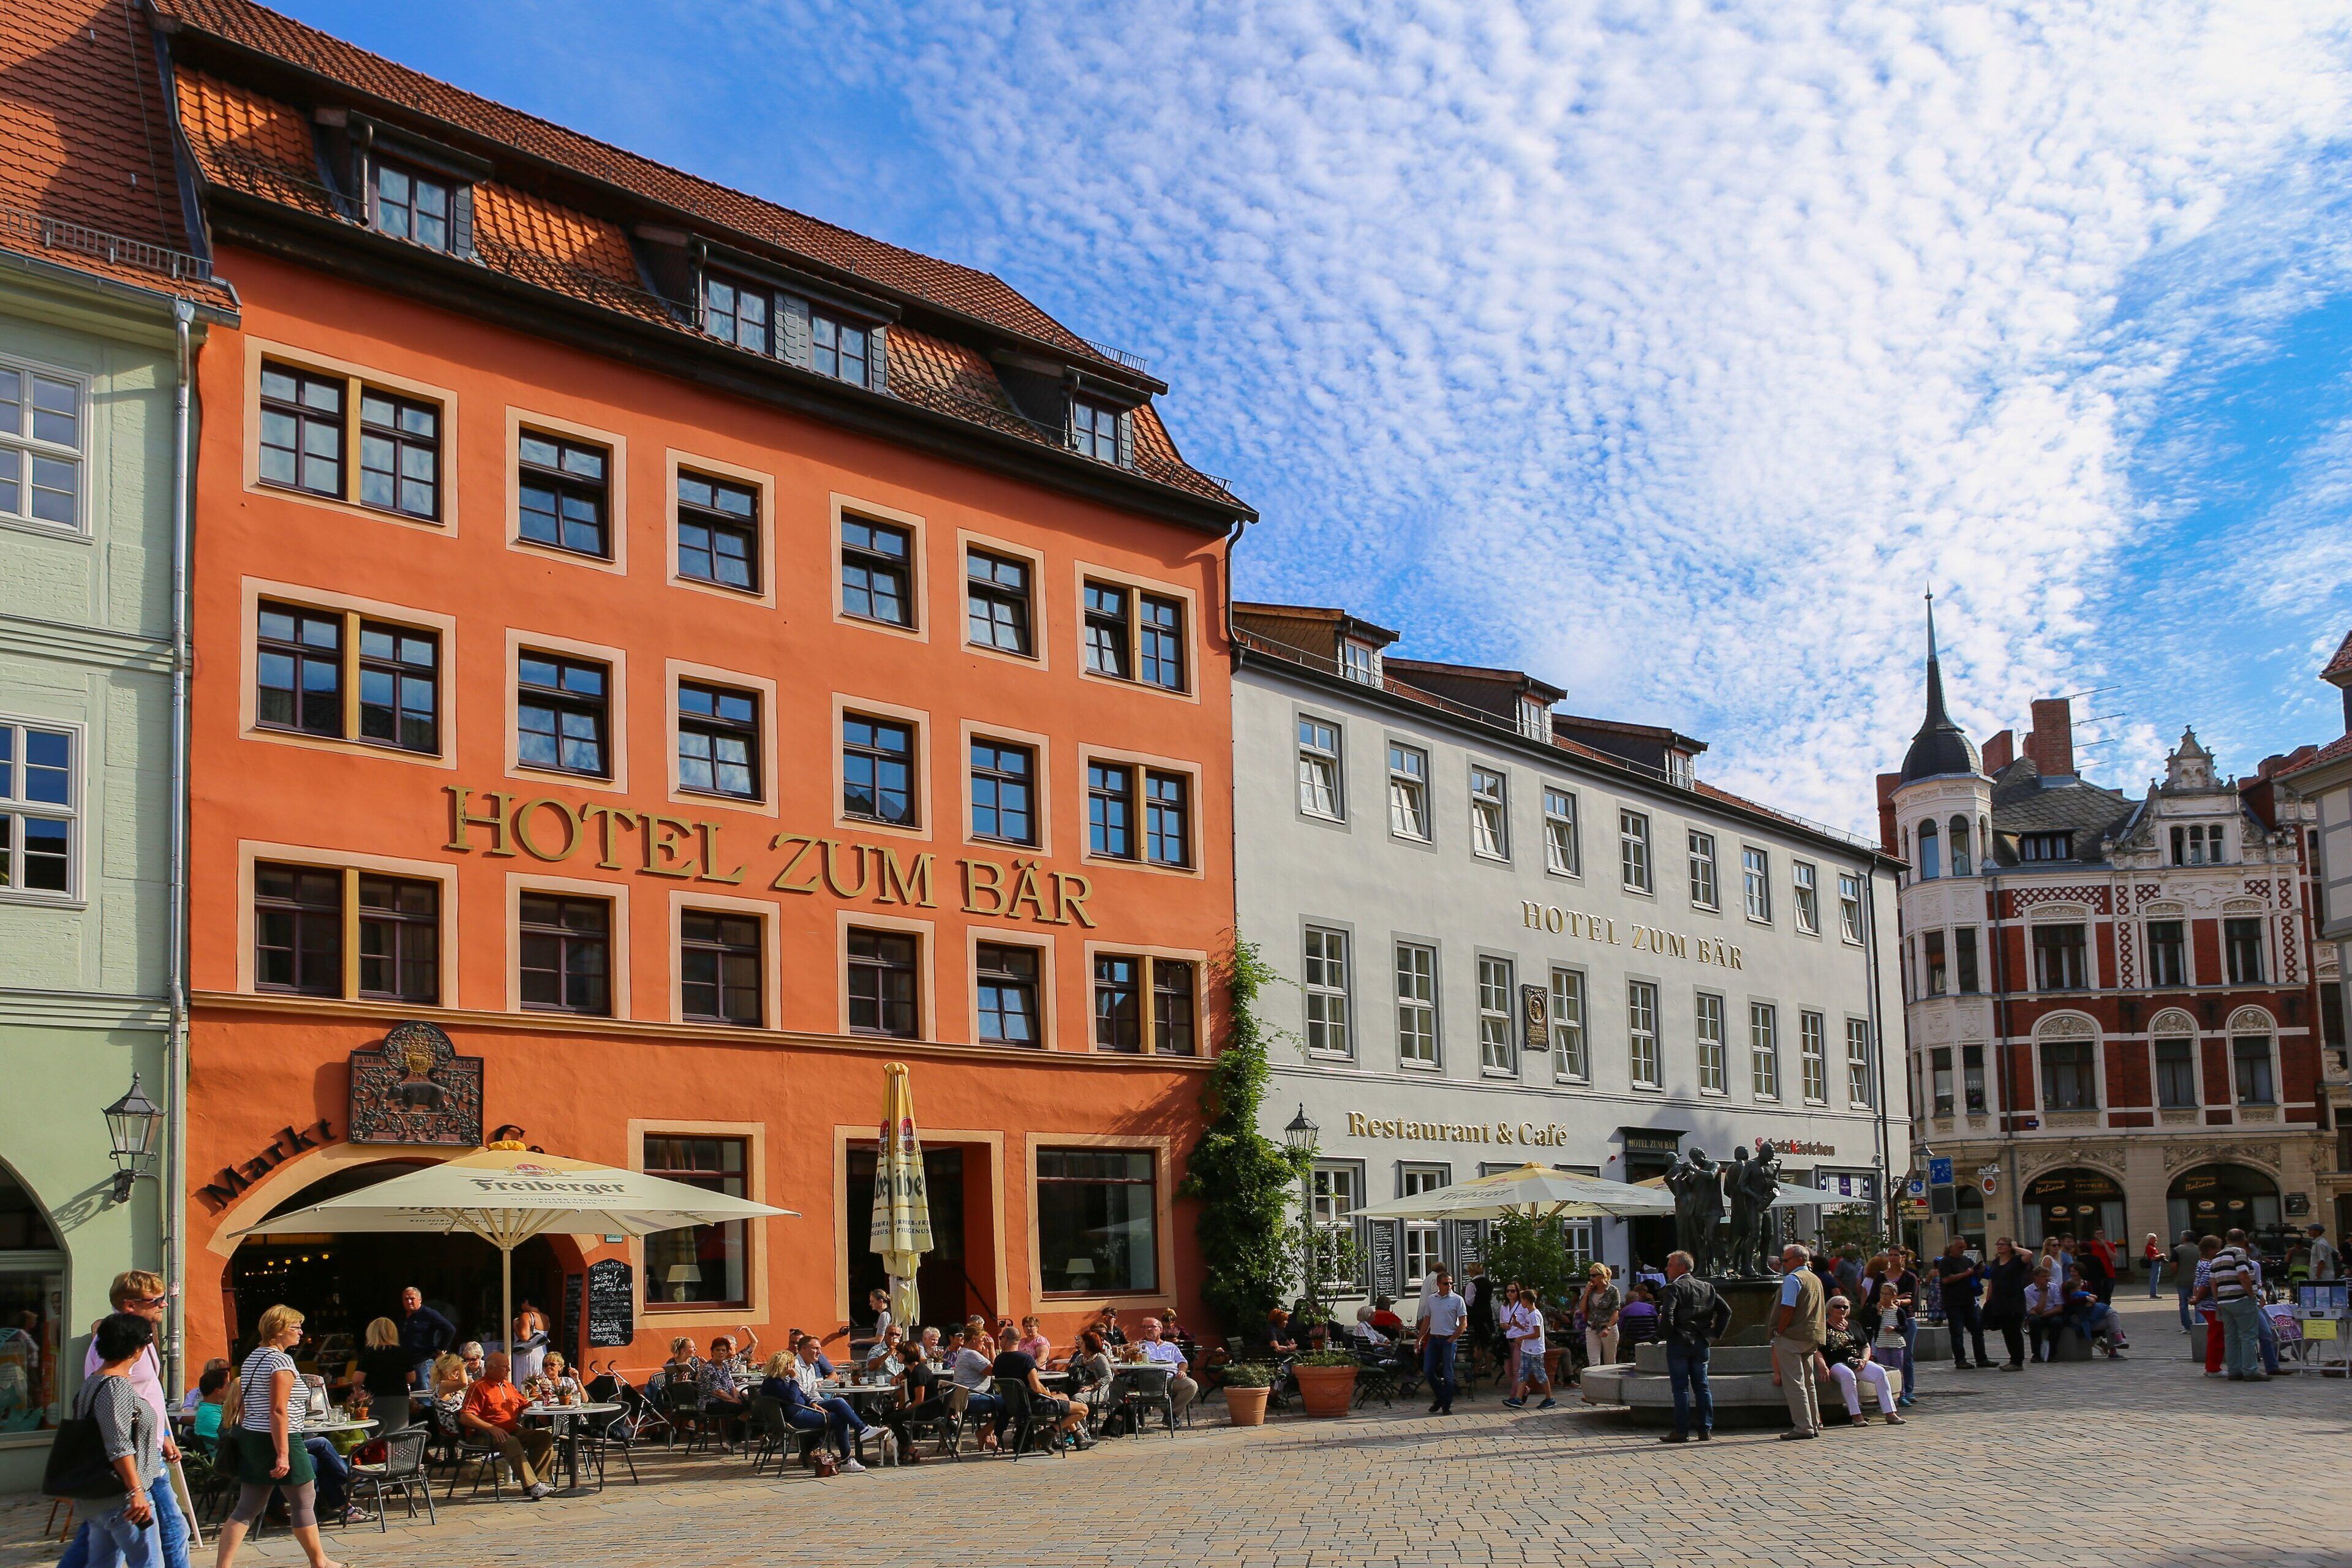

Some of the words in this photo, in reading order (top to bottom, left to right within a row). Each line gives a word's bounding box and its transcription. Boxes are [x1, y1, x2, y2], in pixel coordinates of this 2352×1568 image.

[448, 785, 747, 883] HOTEL
[774, 832, 938, 908] ZUM
[961, 858, 1098, 927] BÄR
[1521, 900, 1621, 945] HOTEL
[1632, 924, 1688, 959] ZUM
[1697, 935, 1743, 970] BÄR
[1346, 1110, 1492, 1144] Restaurant
[1496, 1121, 1515, 1145] &
[1518, 1121, 1568, 1147] Café
[1629, 1139, 1649, 1147] HOTEL
[1650, 1140, 1663, 1149] ZUM
[1664, 1140, 1676, 1150] BÄR
[1755, 1137, 1836, 1156] Shatzkästchen
[200, 1118, 337, 1211] Markt
[470, 1179, 627, 1195] Freiberger
[592, 1262, 625, 1271] Frühstück
